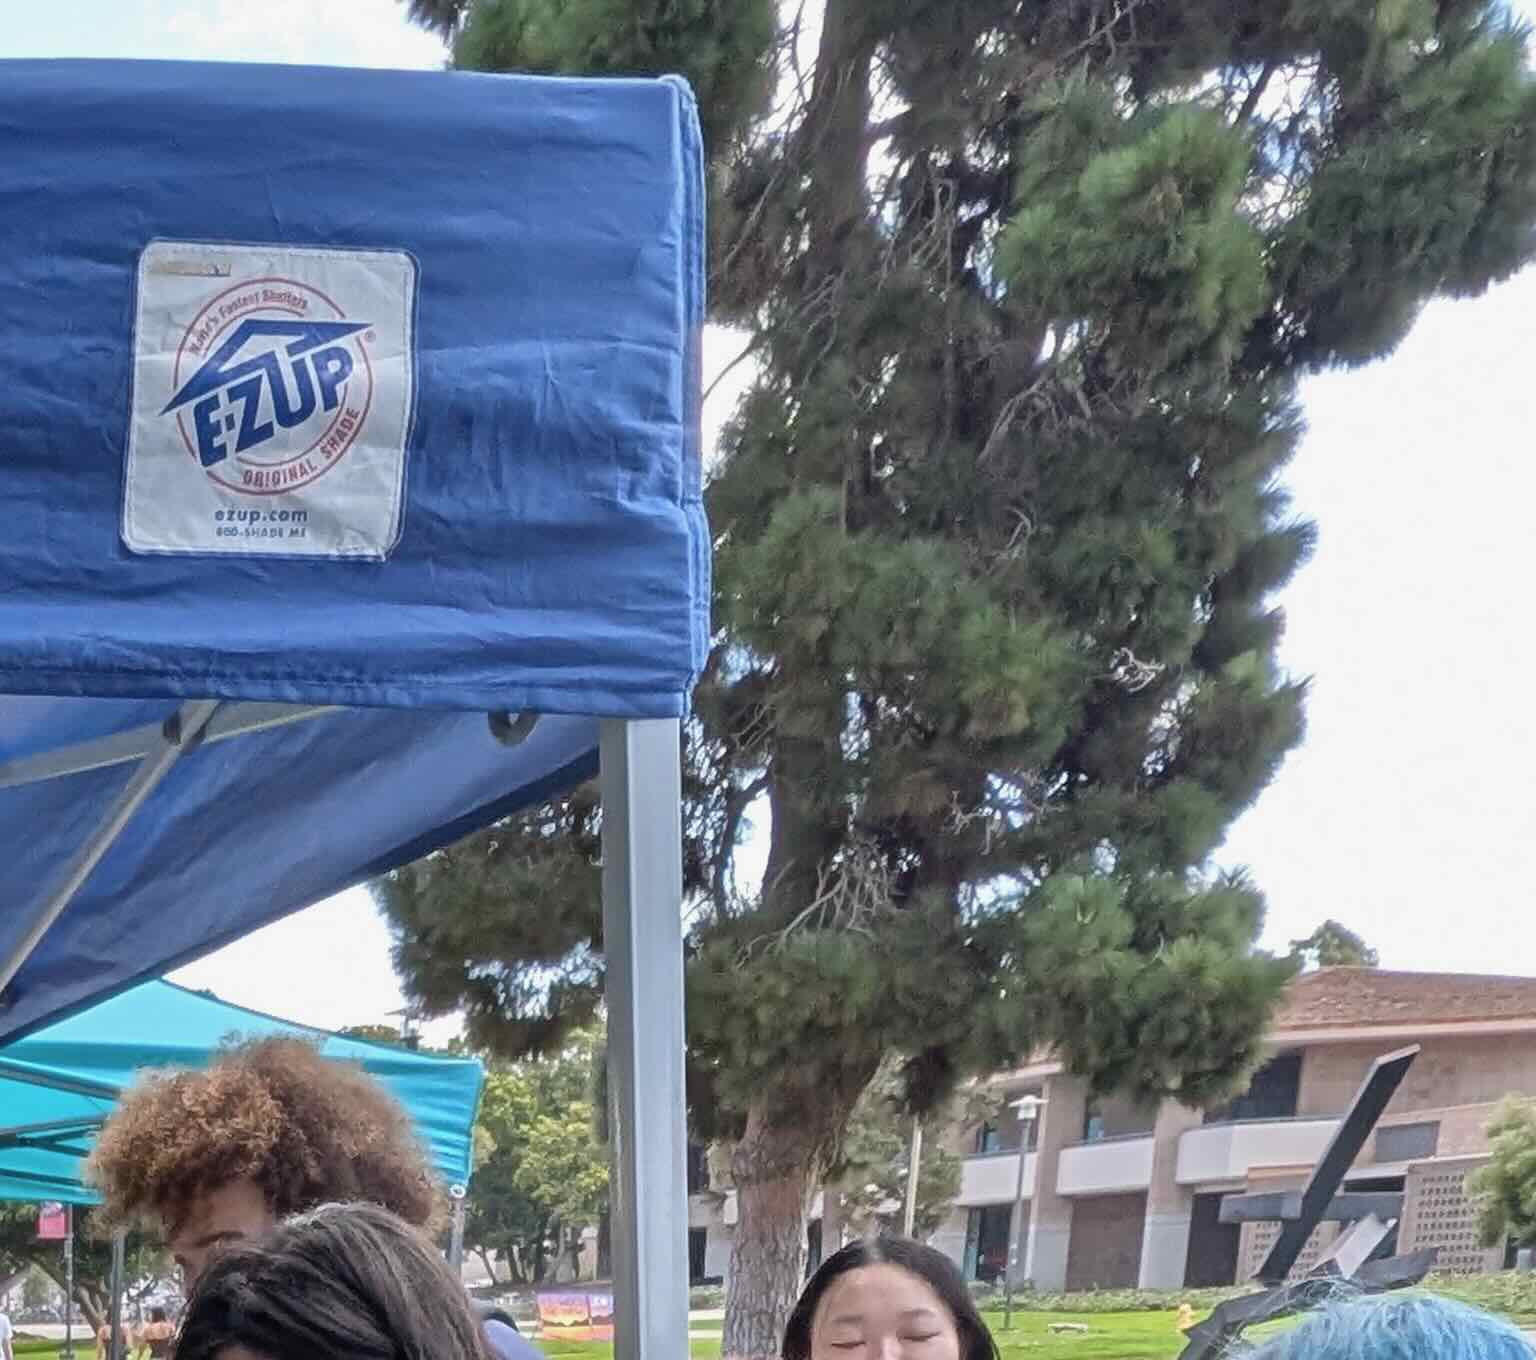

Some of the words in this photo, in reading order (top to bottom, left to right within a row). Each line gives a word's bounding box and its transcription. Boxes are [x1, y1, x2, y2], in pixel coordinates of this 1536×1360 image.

[242, 461, 318, 489] ORIGINAL
[319, 405, 361, 460] SHADE
[214, 509, 308, 526] ezup.com
